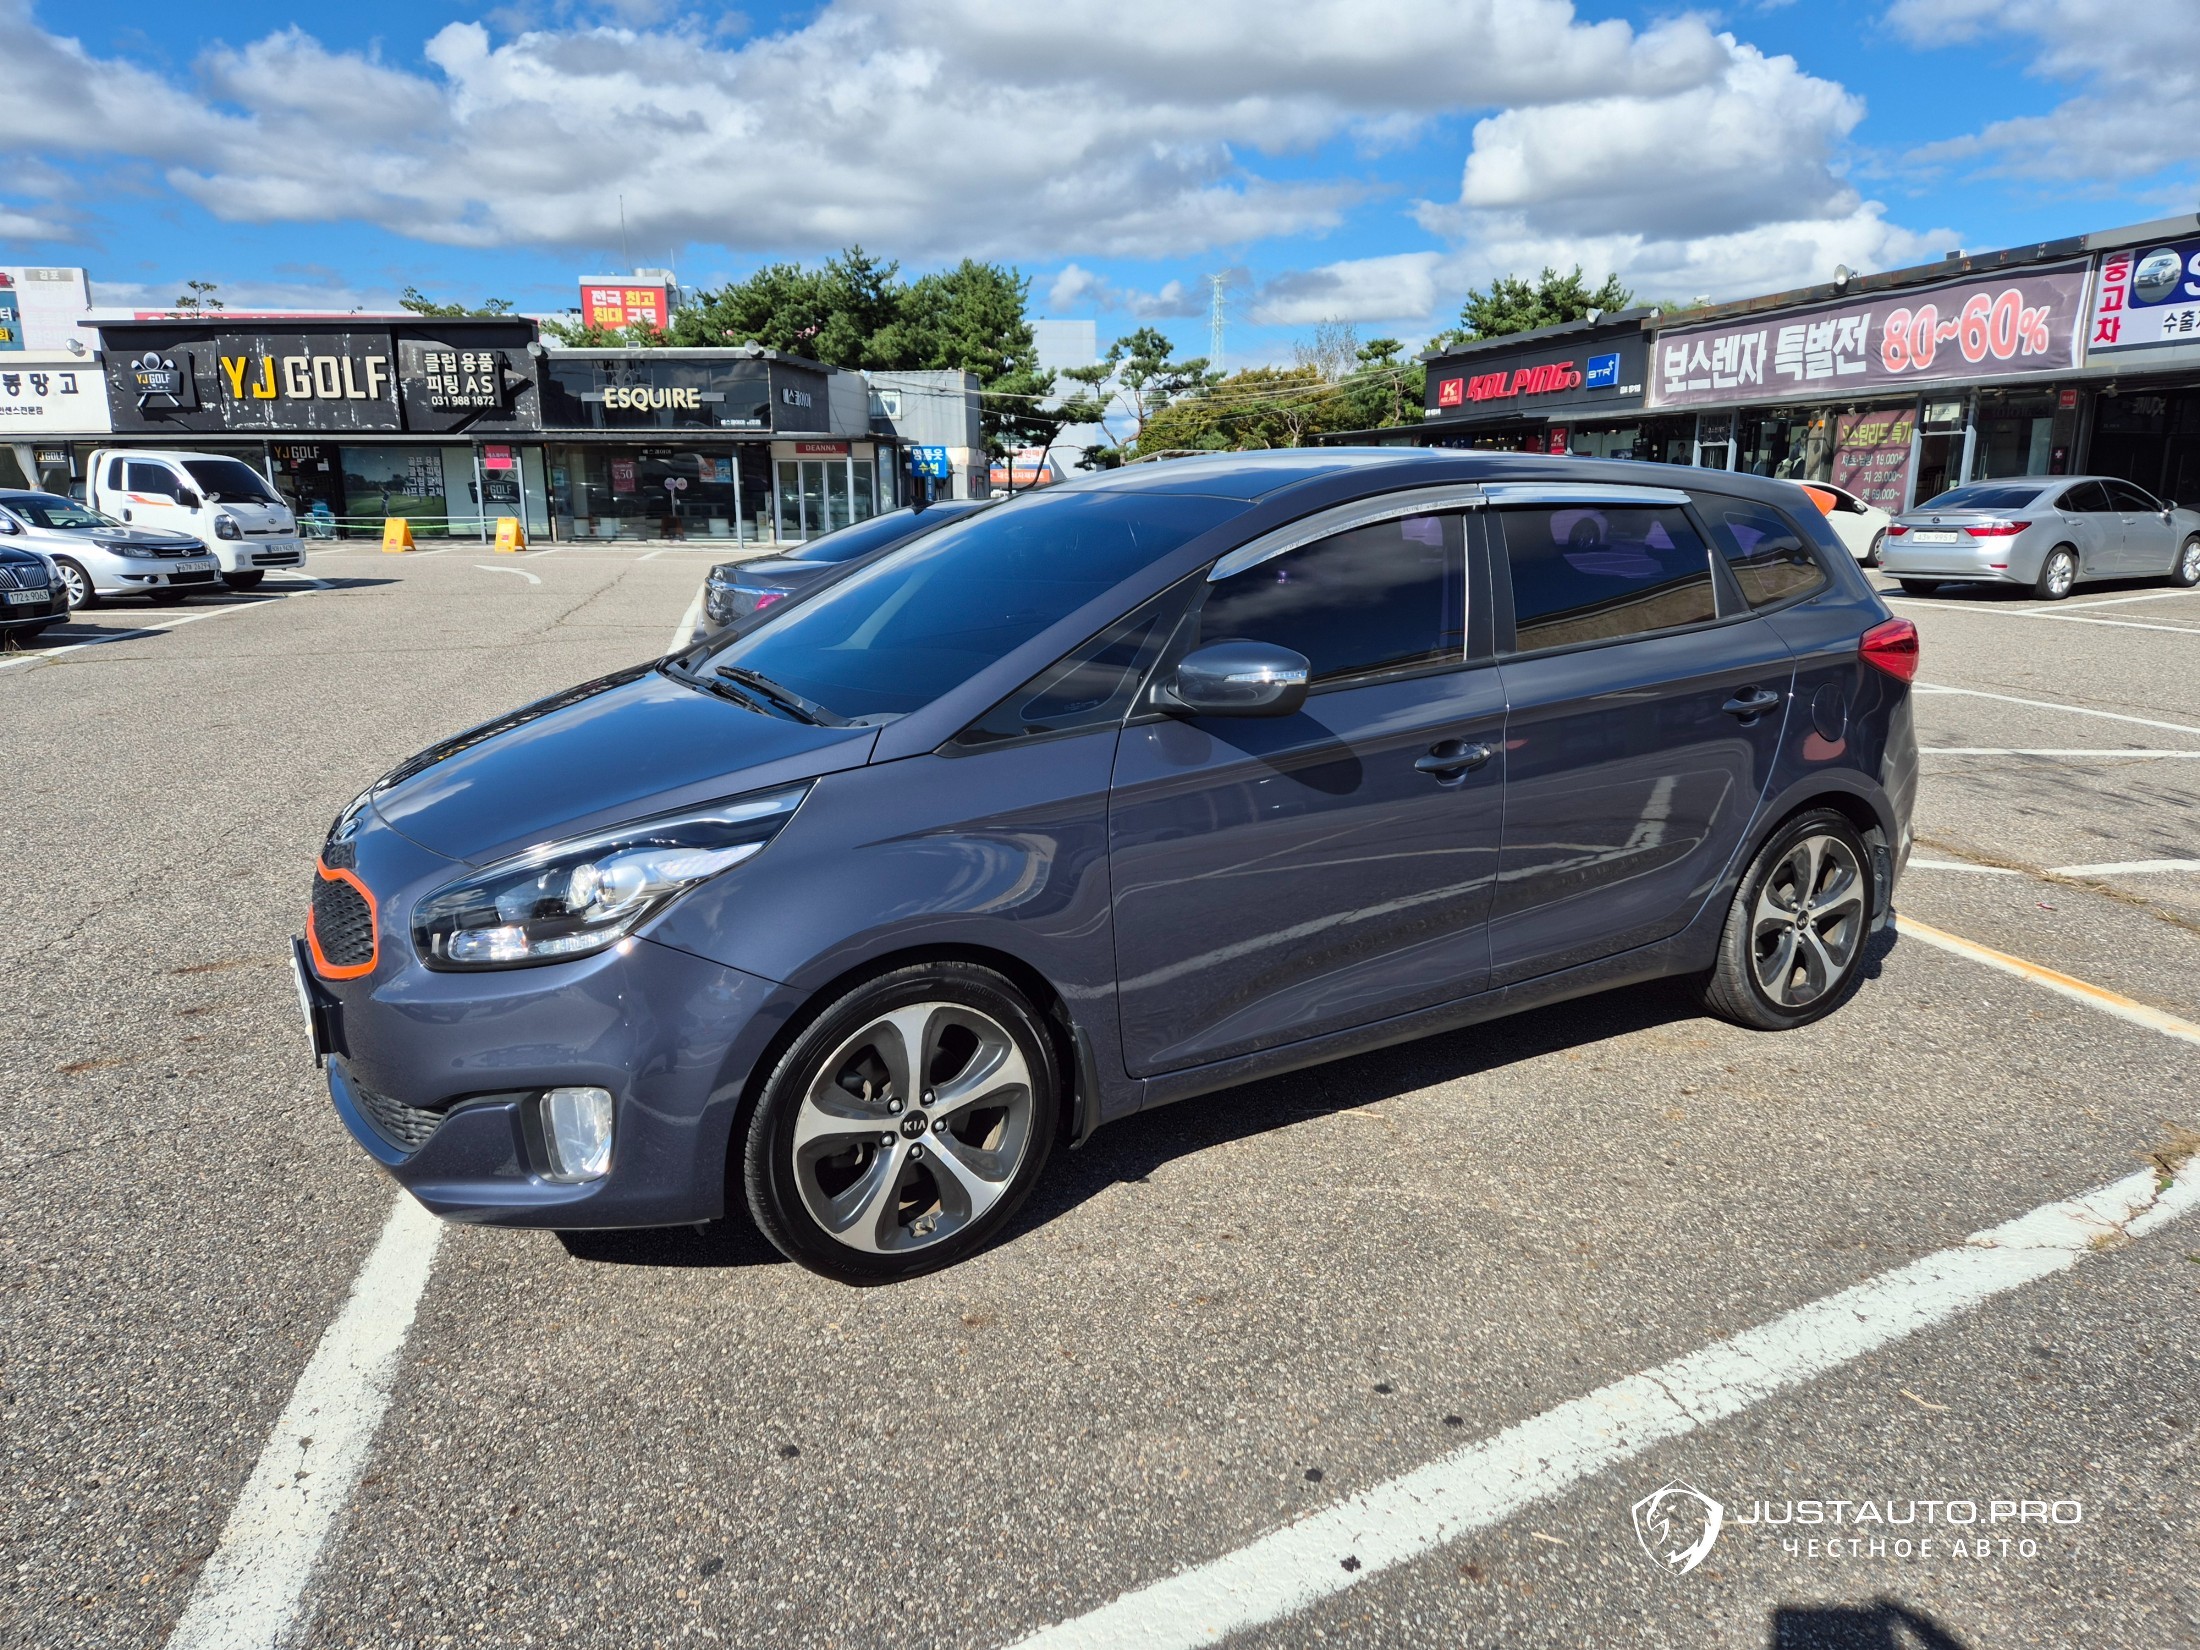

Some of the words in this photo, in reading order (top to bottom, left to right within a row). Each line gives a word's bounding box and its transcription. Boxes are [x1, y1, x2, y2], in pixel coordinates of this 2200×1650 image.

[591, 289, 622, 306] 전국
[625, 290, 656, 307] 최고
[2093, 253, 2131, 344] 중고차
[593, 306, 623, 323] 최대
[1664, 330, 1768, 394] 보스렌자
[1774, 312, 1872, 381] 특별전
[1880, 287, 2051, 374] 80~60%
[424, 352, 458, 373] 클럽
[460, 352, 495, 373] 용품
[283, 356, 387, 399] GOLF
[426, 374, 460, 395] 피팅
[465, 375, 494, 394] AS
[1443, 381, 1458, 397] K
[431, 395, 449, 406] 031
[451, 396, 470, 406] 988
[472, 396, 496, 406] 1872
[602, 387, 701, 412] ESQUIRE
[1891, 420, 1912, 444] 특가
[291, 447, 320, 459] GOLF
[805, 444, 837, 452] DEANNA
[912, 448, 944, 461] 명품옷
[918, 462, 939, 475] 수선
[903, 1119, 926, 1132] KIA
